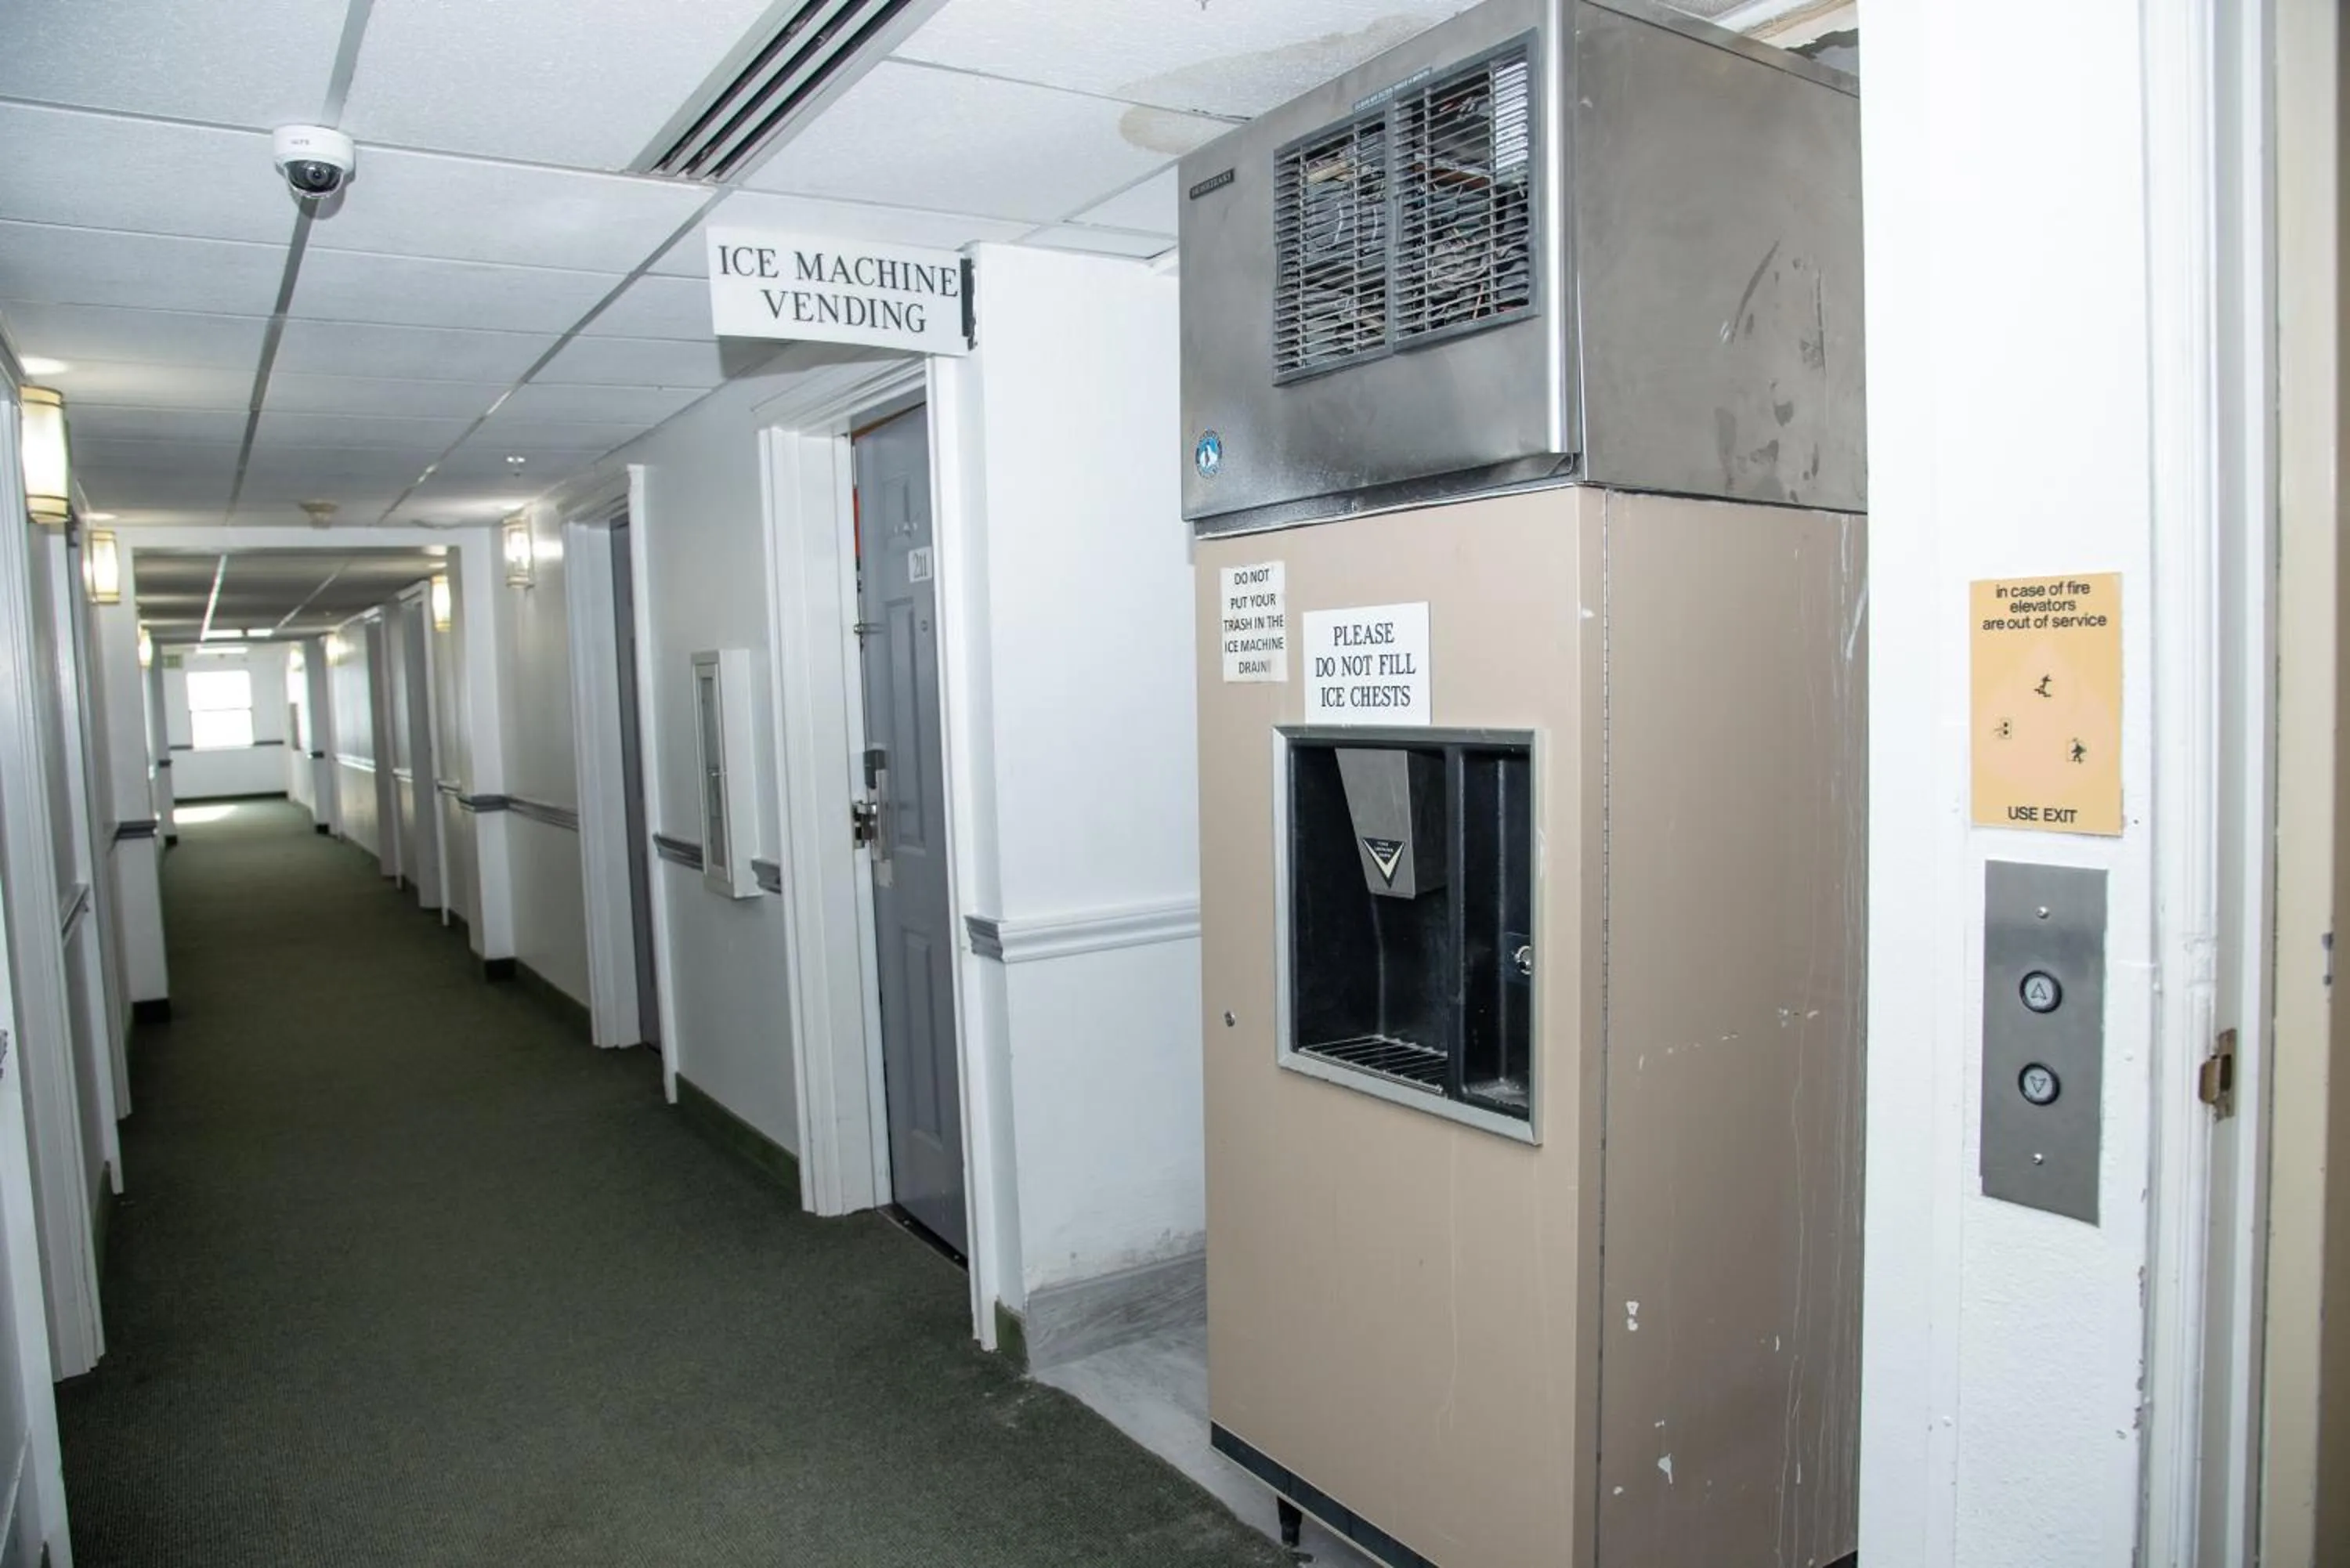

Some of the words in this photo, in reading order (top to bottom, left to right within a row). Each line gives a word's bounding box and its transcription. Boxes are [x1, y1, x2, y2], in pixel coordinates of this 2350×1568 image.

[718, 245, 779, 278] ICE
[794, 251, 959, 297] MACHINE
[761, 289, 927, 333] VENDING
[1234, 572, 1248, 585] DO
[1249, 569, 1269, 583] NOT
[1996, 583, 2008, 598] in
[2011, 583, 2045, 598] case
[2049, 581, 2064, 595] of
[2067, 580, 2091, 595] fire
[1231, 596, 1247, 609] PUT
[1250, 594, 1276, 608] YOUR
[2010, 597, 2076, 613] elevators
[1224, 617, 1253, 632] TRASH
[1254, 616, 1264, 629] IN
[1267, 614, 1284, 628] THE
[1983, 617, 2005, 630] are
[2007, 615, 2030, 630] out
[2034, 614, 2048, 629] of
[2052, 612, 2107, 628] service
[1333, 622, 1395, 647] PLEASE
[1224, 640, 1238, 652] ICE
[1240, 637, 1284, 652] MACHINE
[1315, 657, 1336, 677] DO
[1341, 655, 1372, 676] NOT
[1379, 652, 1416, 675] FILL
[1321, 687, 1345, 707] ICE
[1350, 685, 1411, 707] CHESTS
[2008, 806, 2038, 822] USE
[2044, 807, 2078, 823] EXIT
